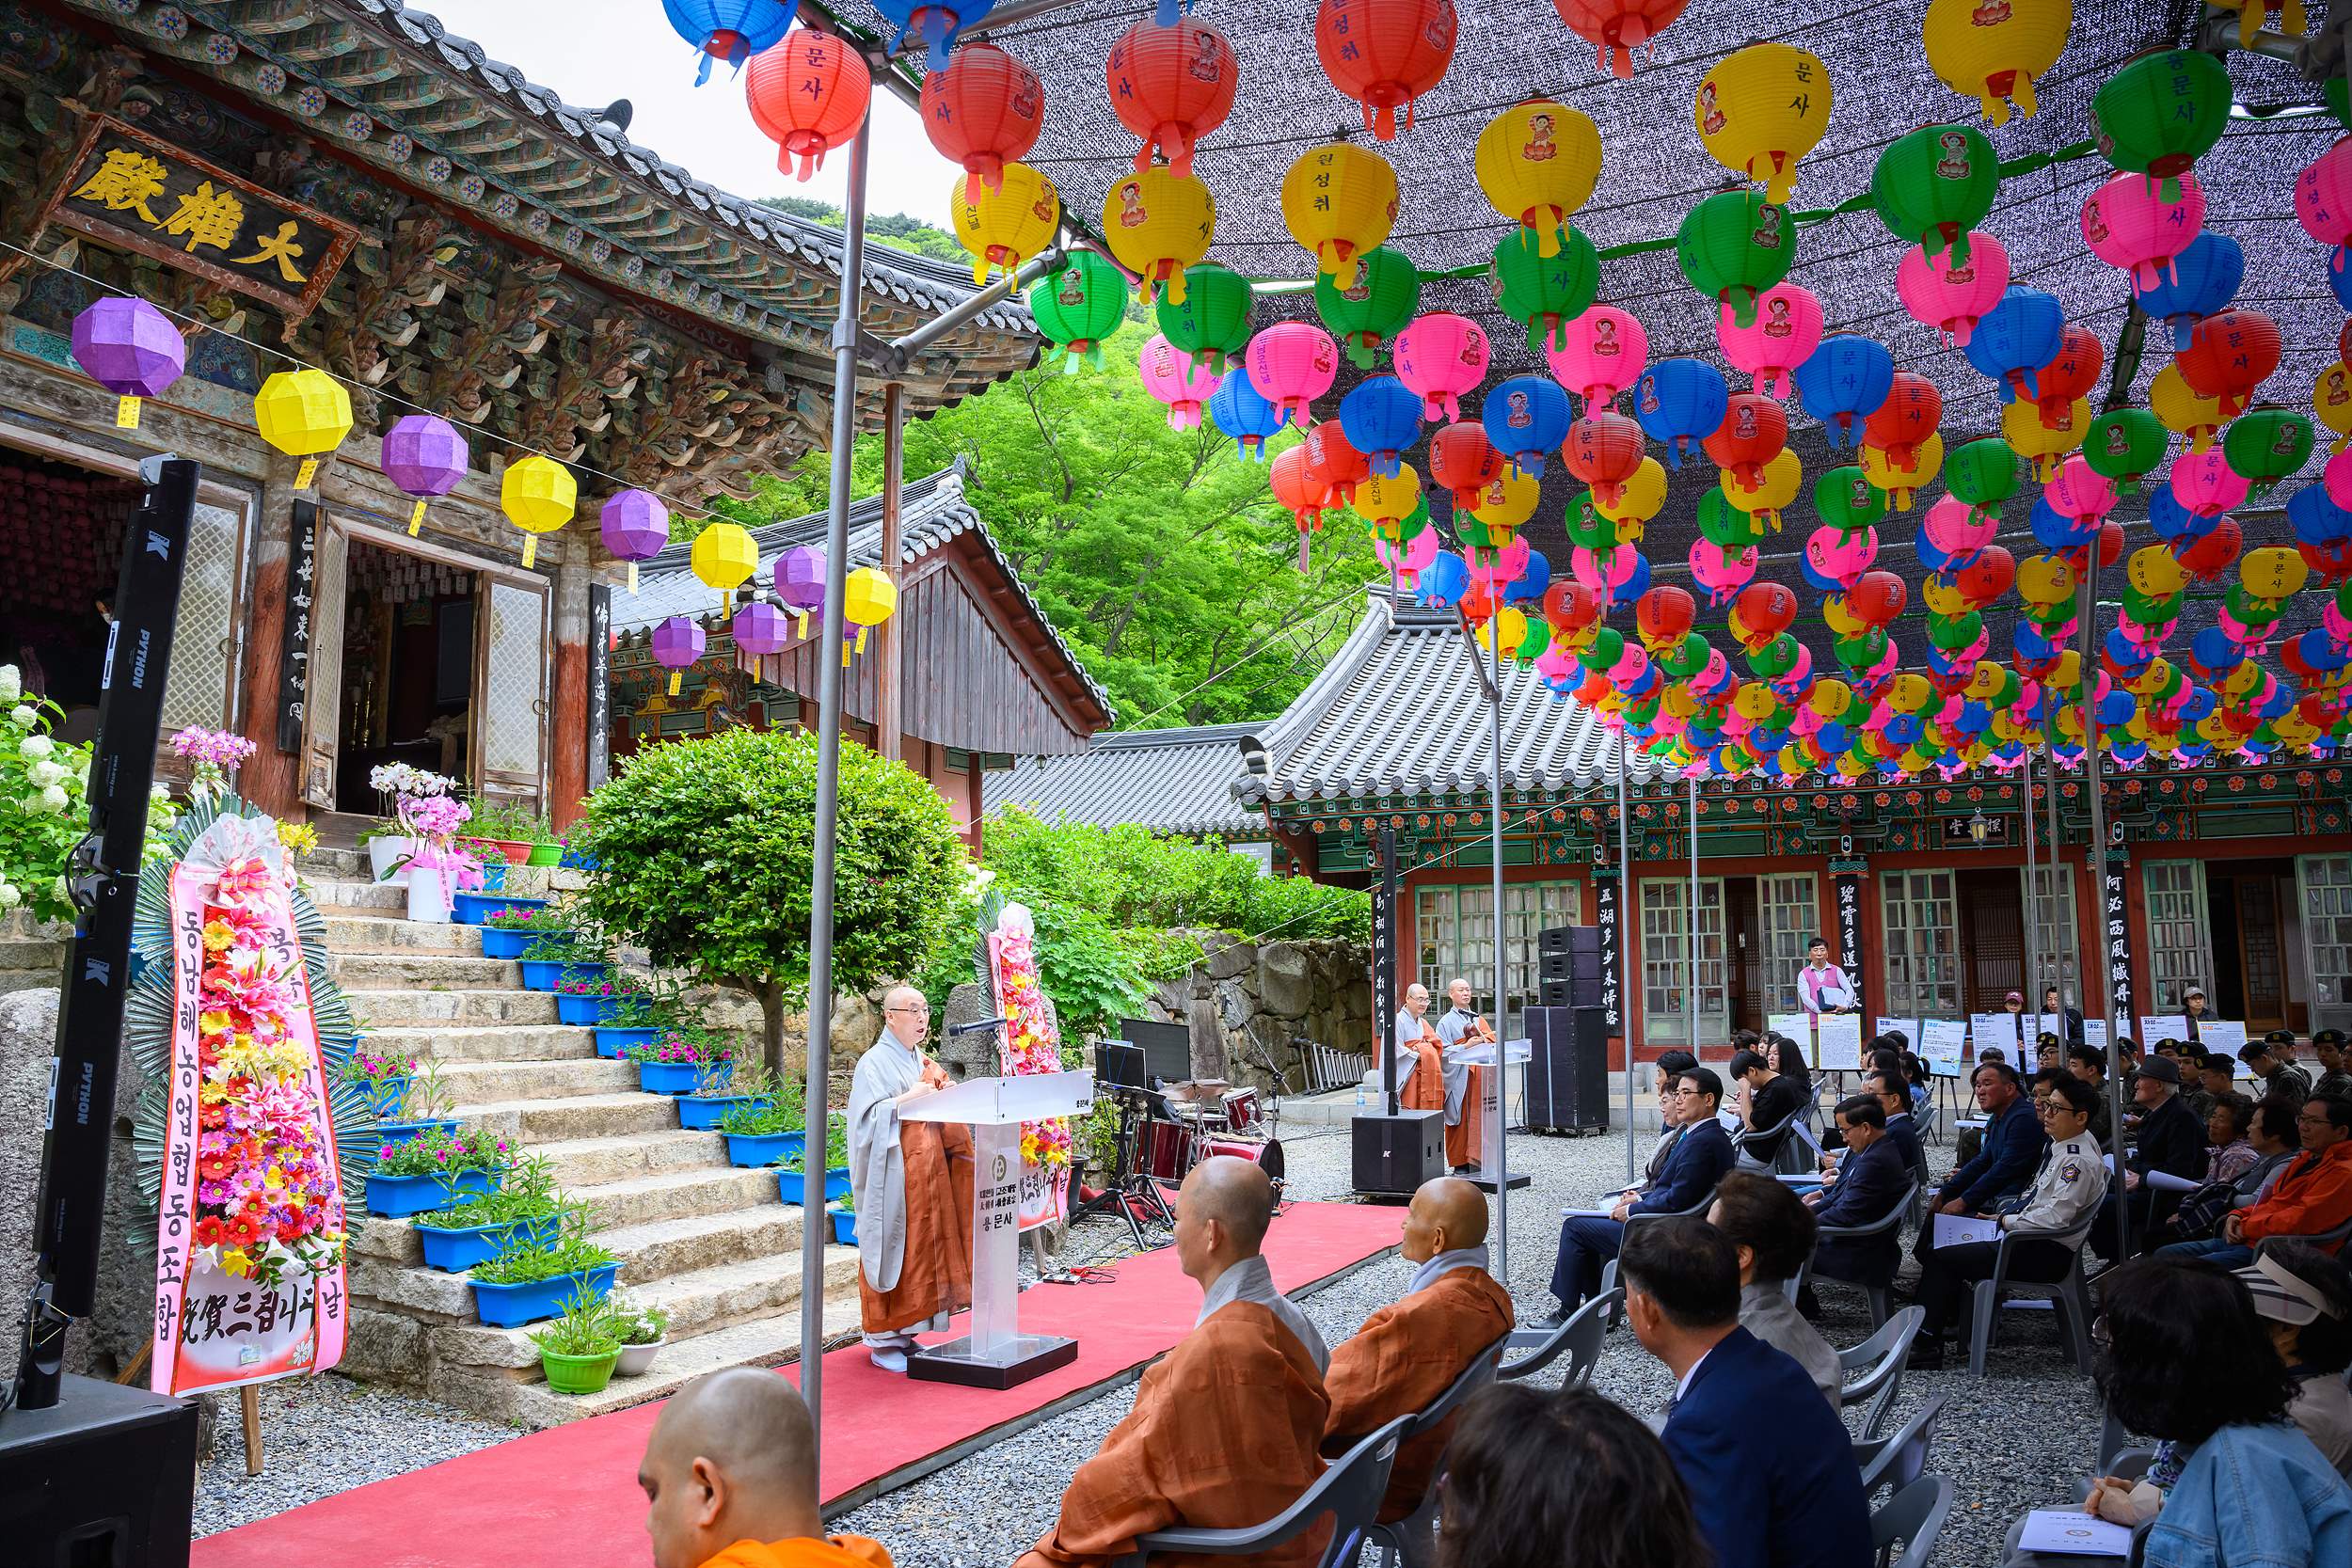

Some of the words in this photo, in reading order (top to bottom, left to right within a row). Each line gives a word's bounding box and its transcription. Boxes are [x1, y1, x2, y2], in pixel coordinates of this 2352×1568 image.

[133, 628, 151, 689] PYTHON
[77, 1061, 94, 1125] PYTHON
[982, 1212, 1013, 1232] 용문사
